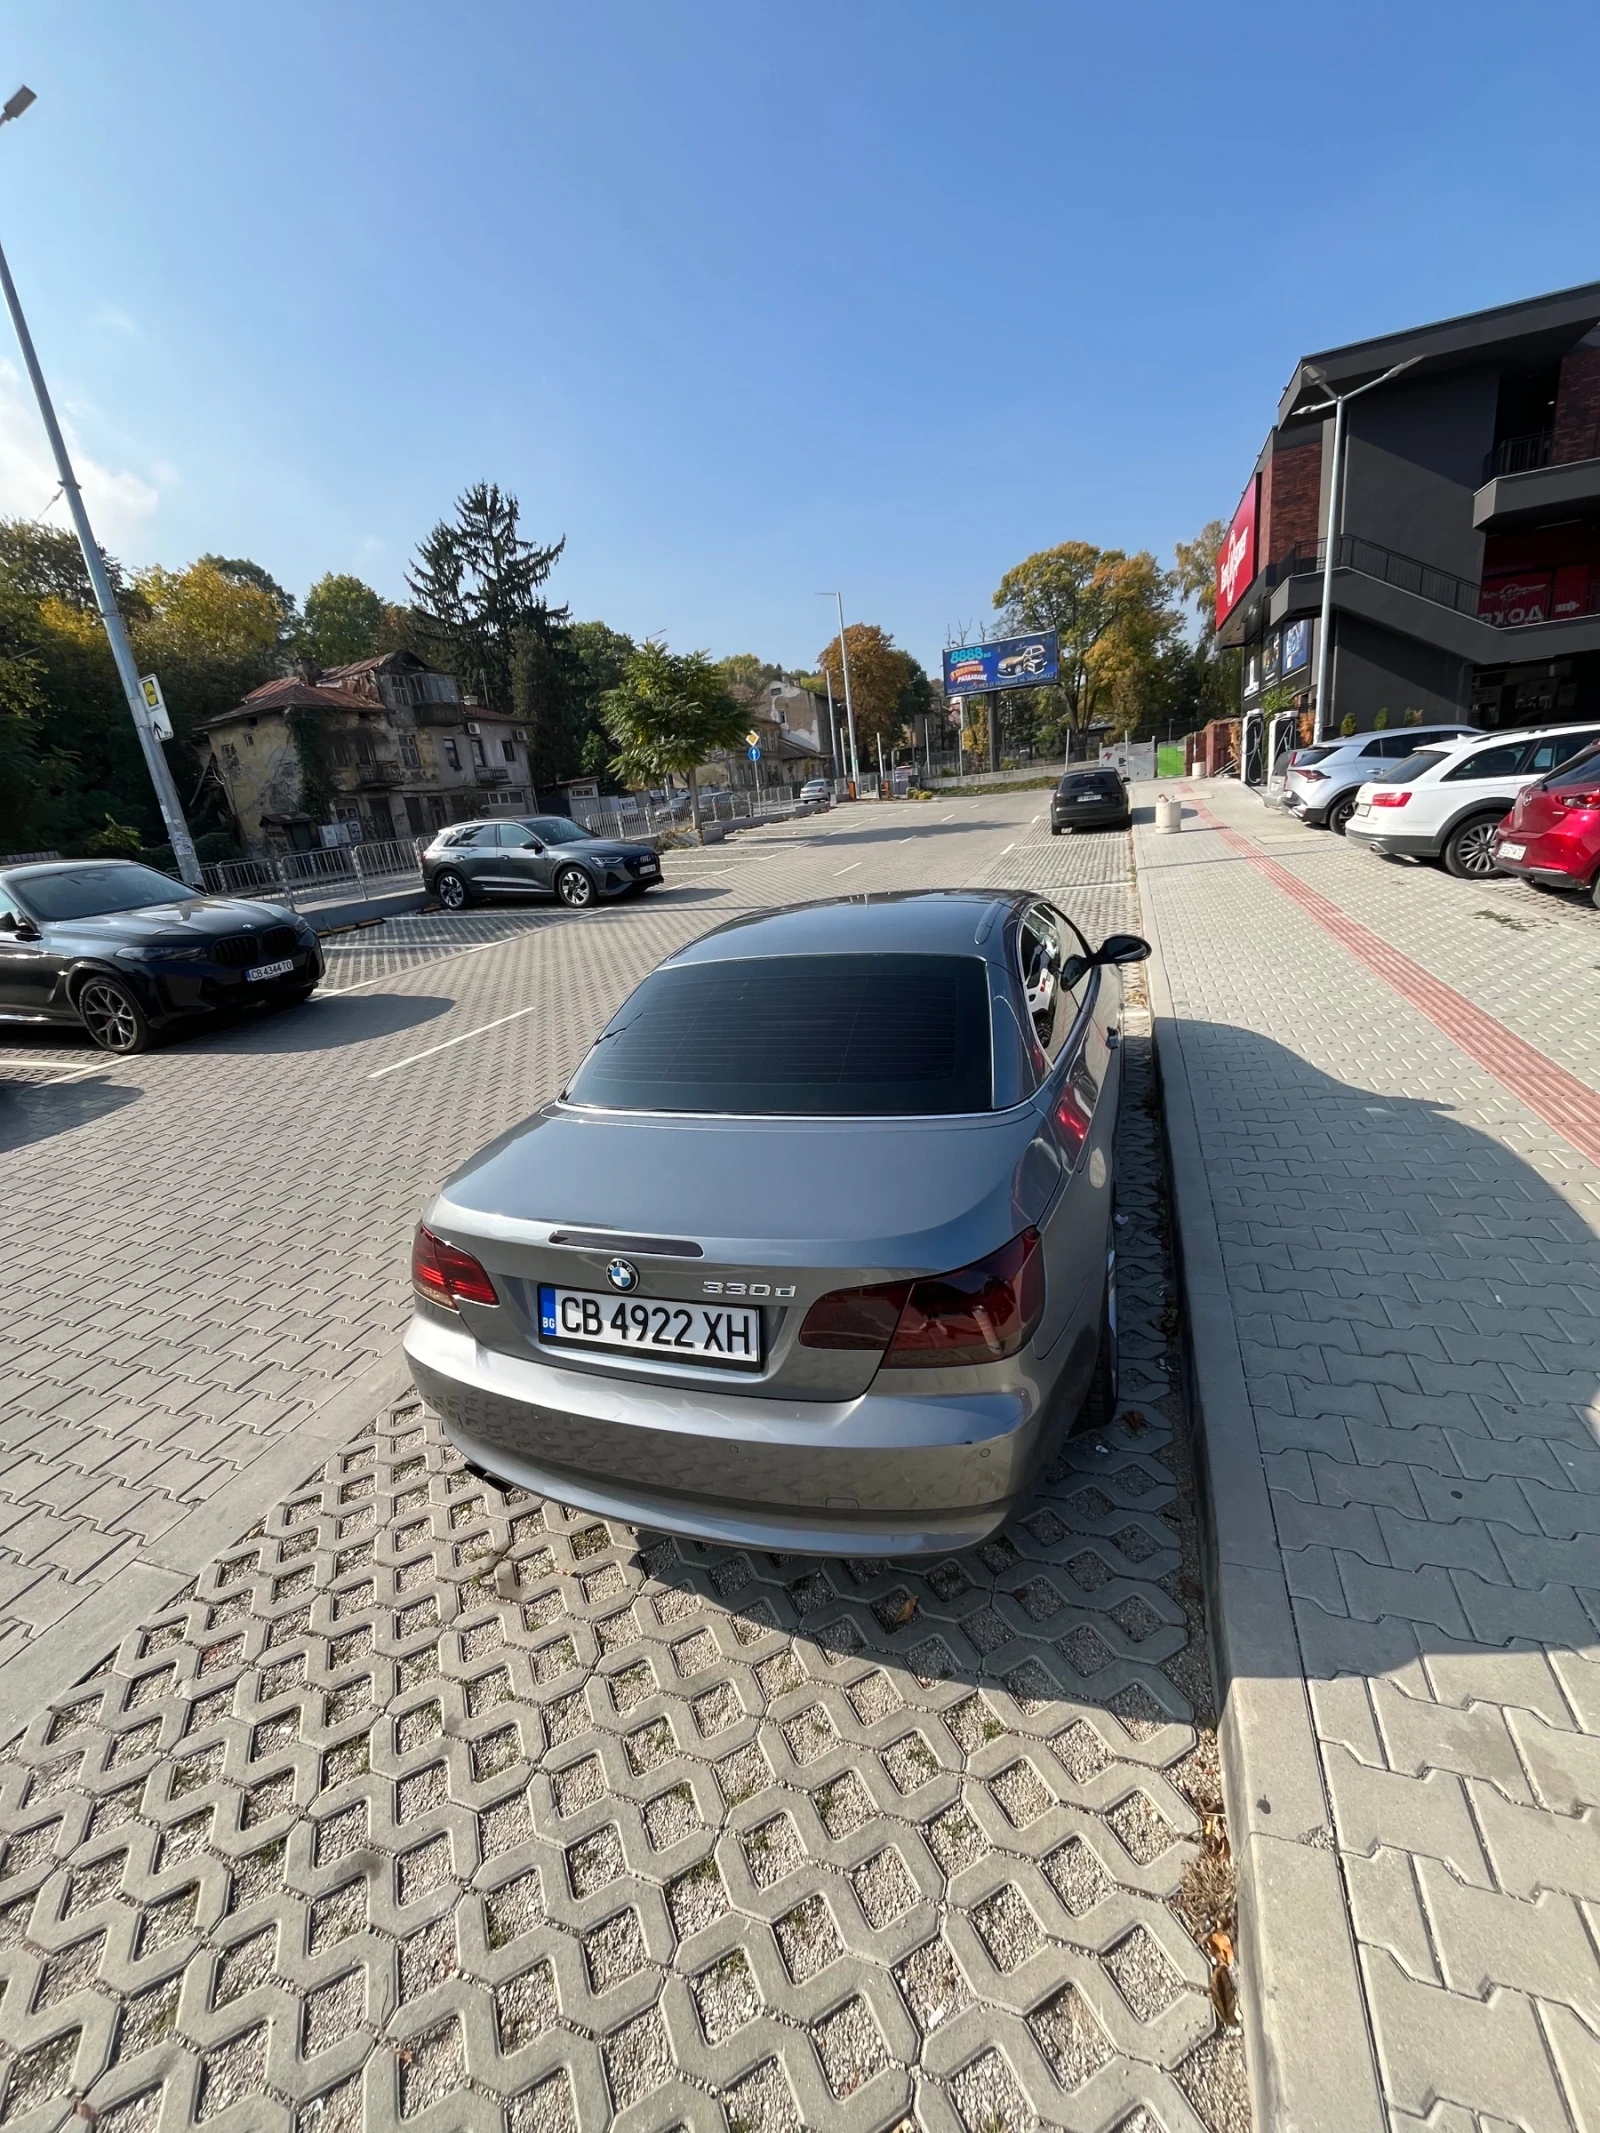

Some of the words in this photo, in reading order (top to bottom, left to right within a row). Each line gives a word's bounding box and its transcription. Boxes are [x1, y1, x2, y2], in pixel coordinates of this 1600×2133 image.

[252, 970, 262, 979] CB
[264, 964, 281, 975] 4344
[702, 1281, 796, 1297] 330d
[542, 1317, 555, 1329] BG
[561, 1297, 603, 1335] CB
[610, 1303, 694, 1348] 4922
[703, 1312, 750, 1355] XH
